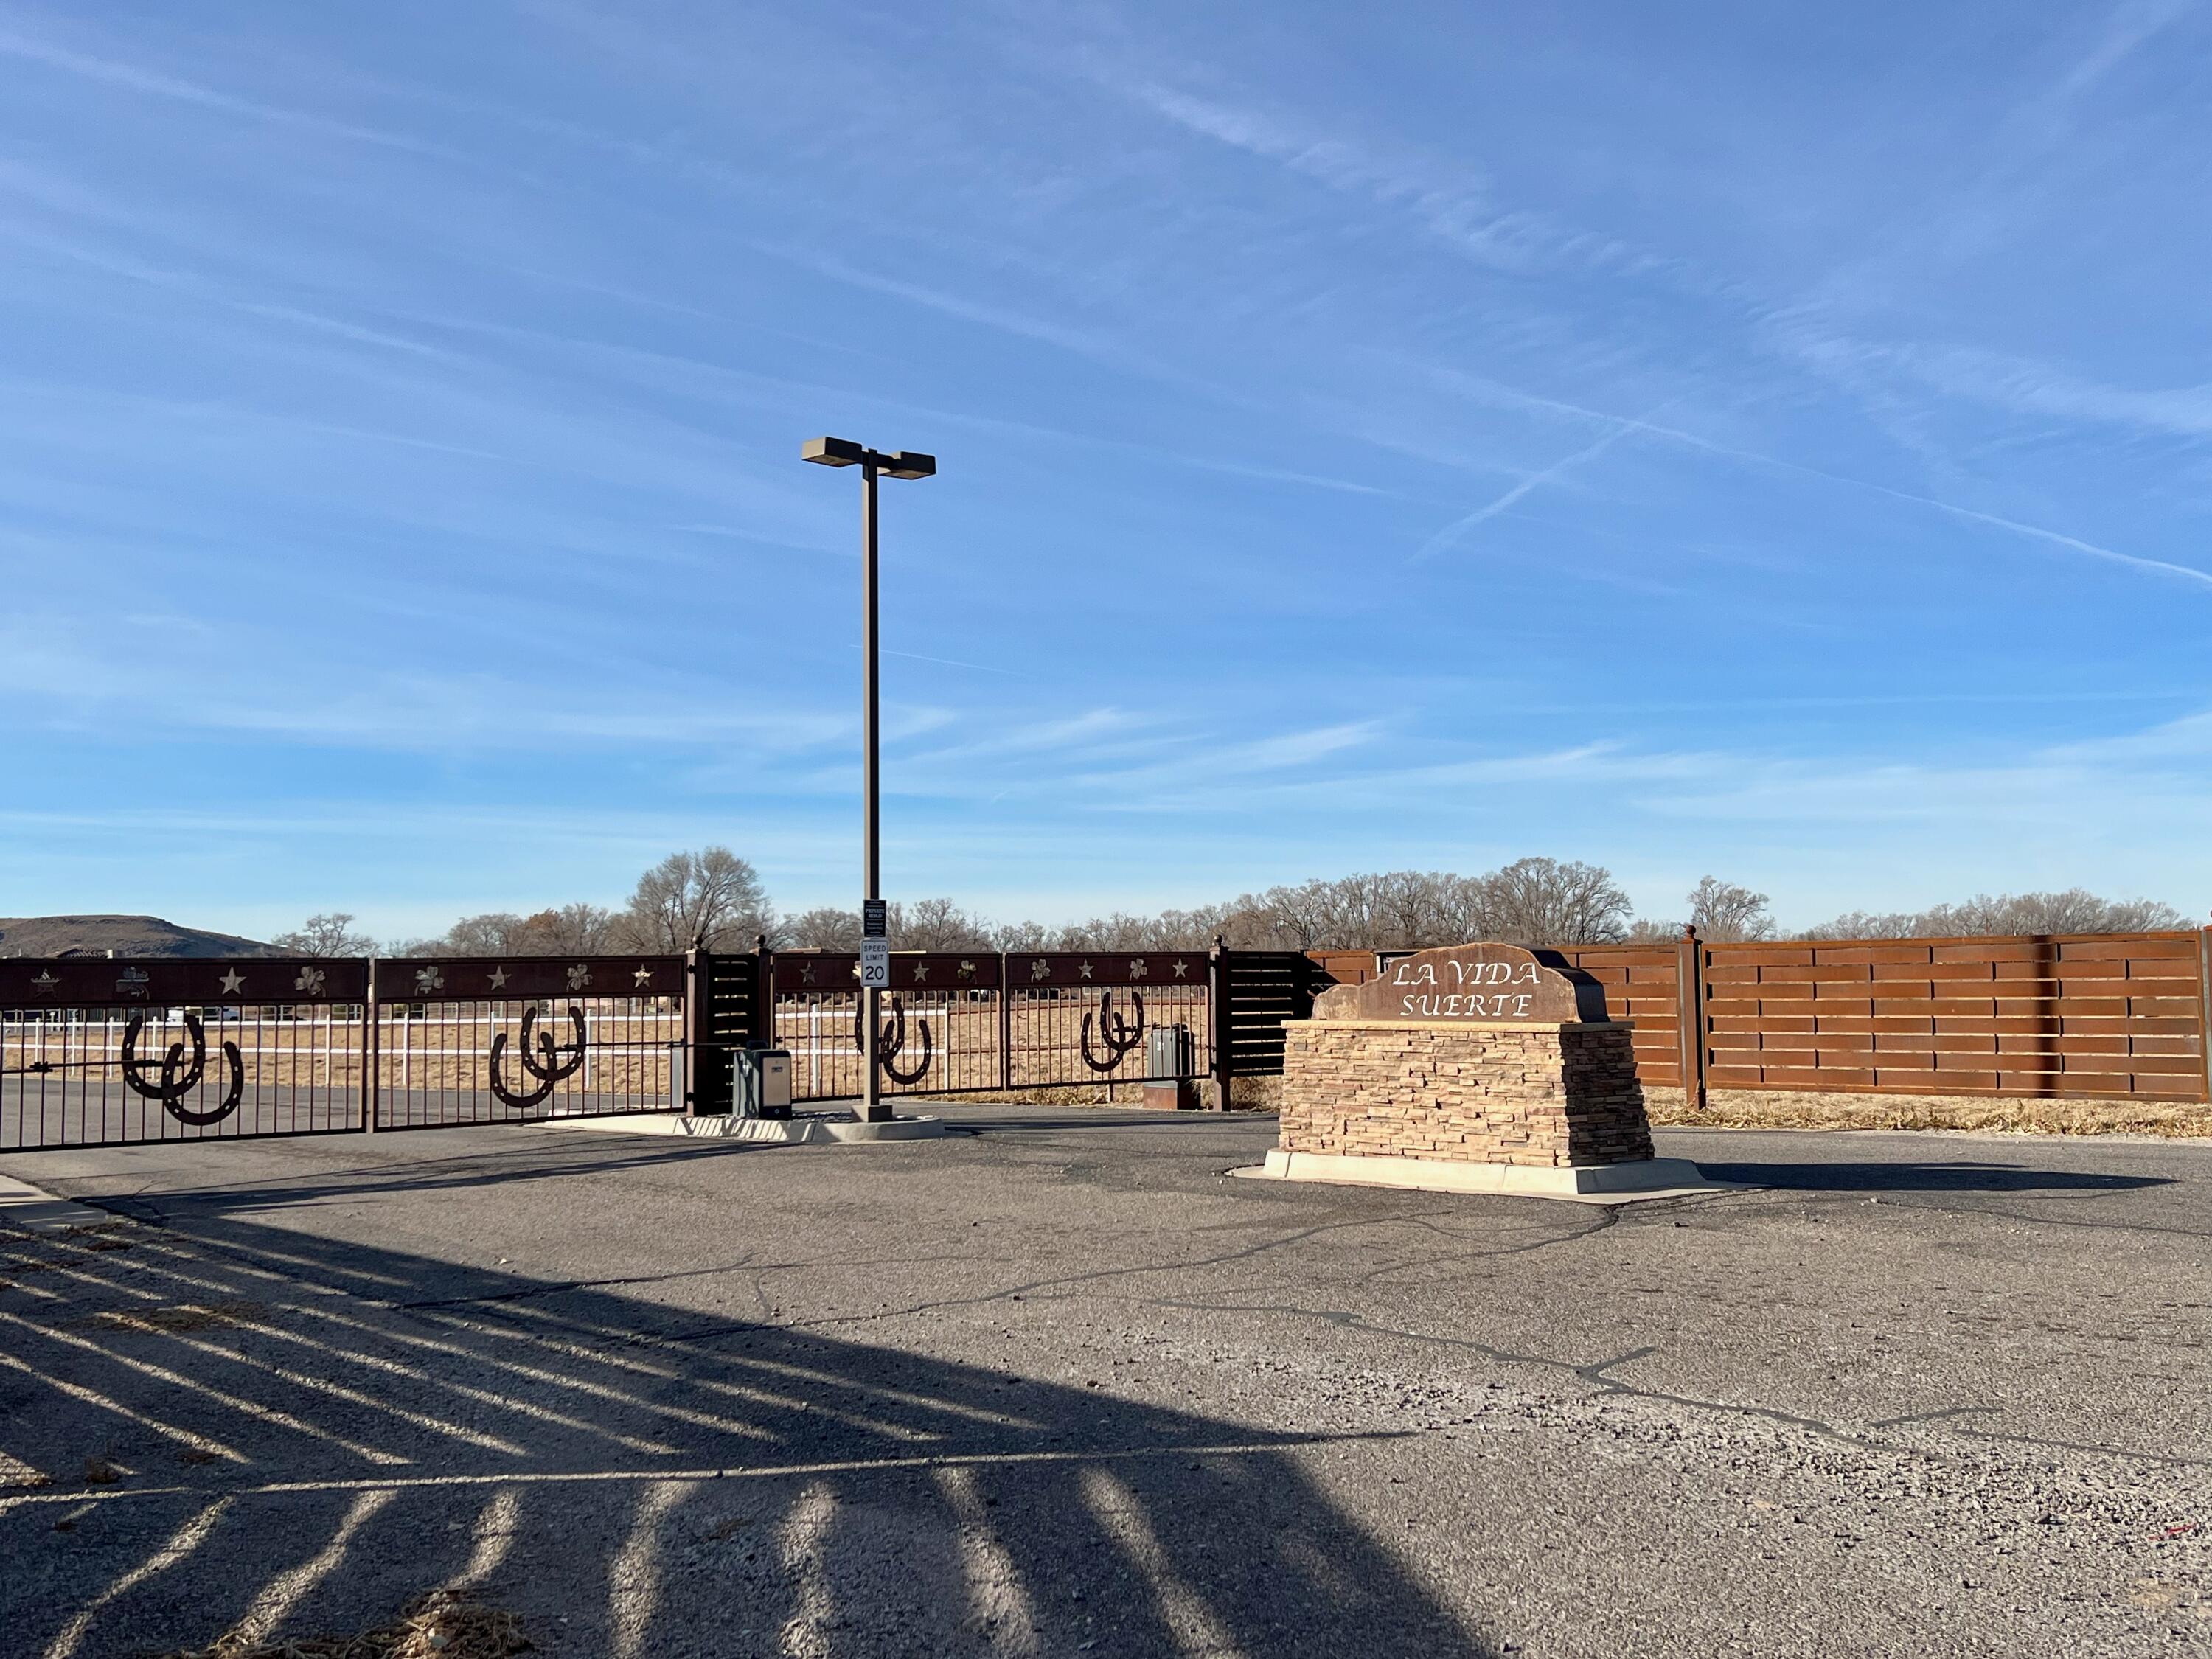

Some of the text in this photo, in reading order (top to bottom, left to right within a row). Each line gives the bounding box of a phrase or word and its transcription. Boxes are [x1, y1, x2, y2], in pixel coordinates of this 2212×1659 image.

[865, 966, 885, 980] 20
[1392, 960, 1541, 985] LA VIDA
[1399, 992, 1533, 1017] SUERTE
